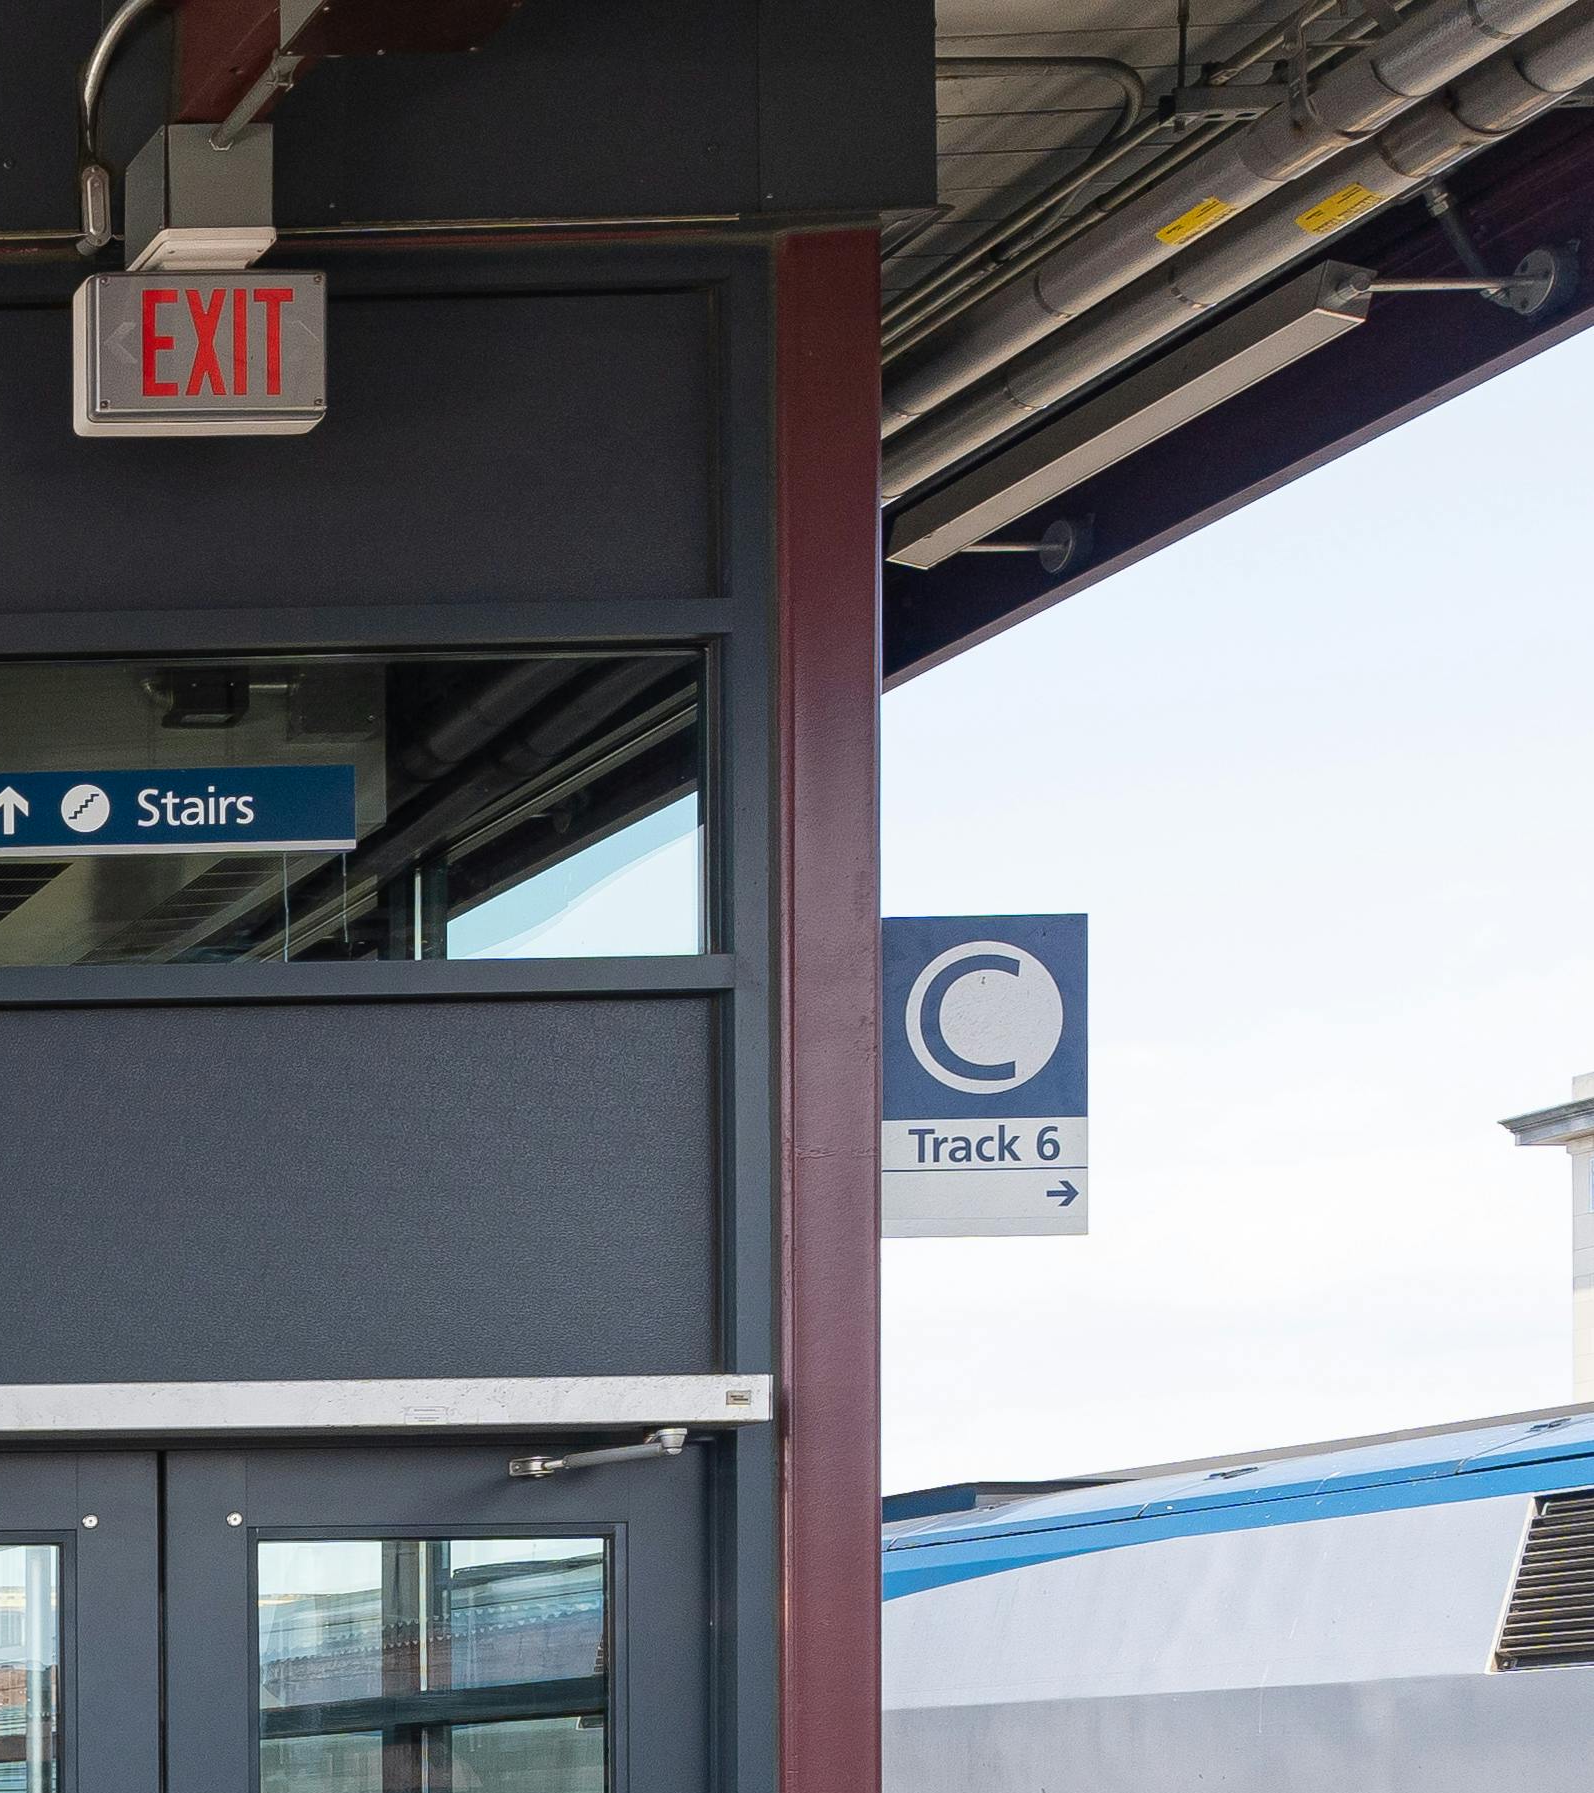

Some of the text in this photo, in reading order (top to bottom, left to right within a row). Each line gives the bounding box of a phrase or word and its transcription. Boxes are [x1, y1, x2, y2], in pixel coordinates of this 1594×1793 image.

[141, 288, 294, 397] EXIT
[137, 785, 255, 828] Stairs
[920, 954, 1021, 1081] C
[908, 1125, 1061, 1163] Track 6
